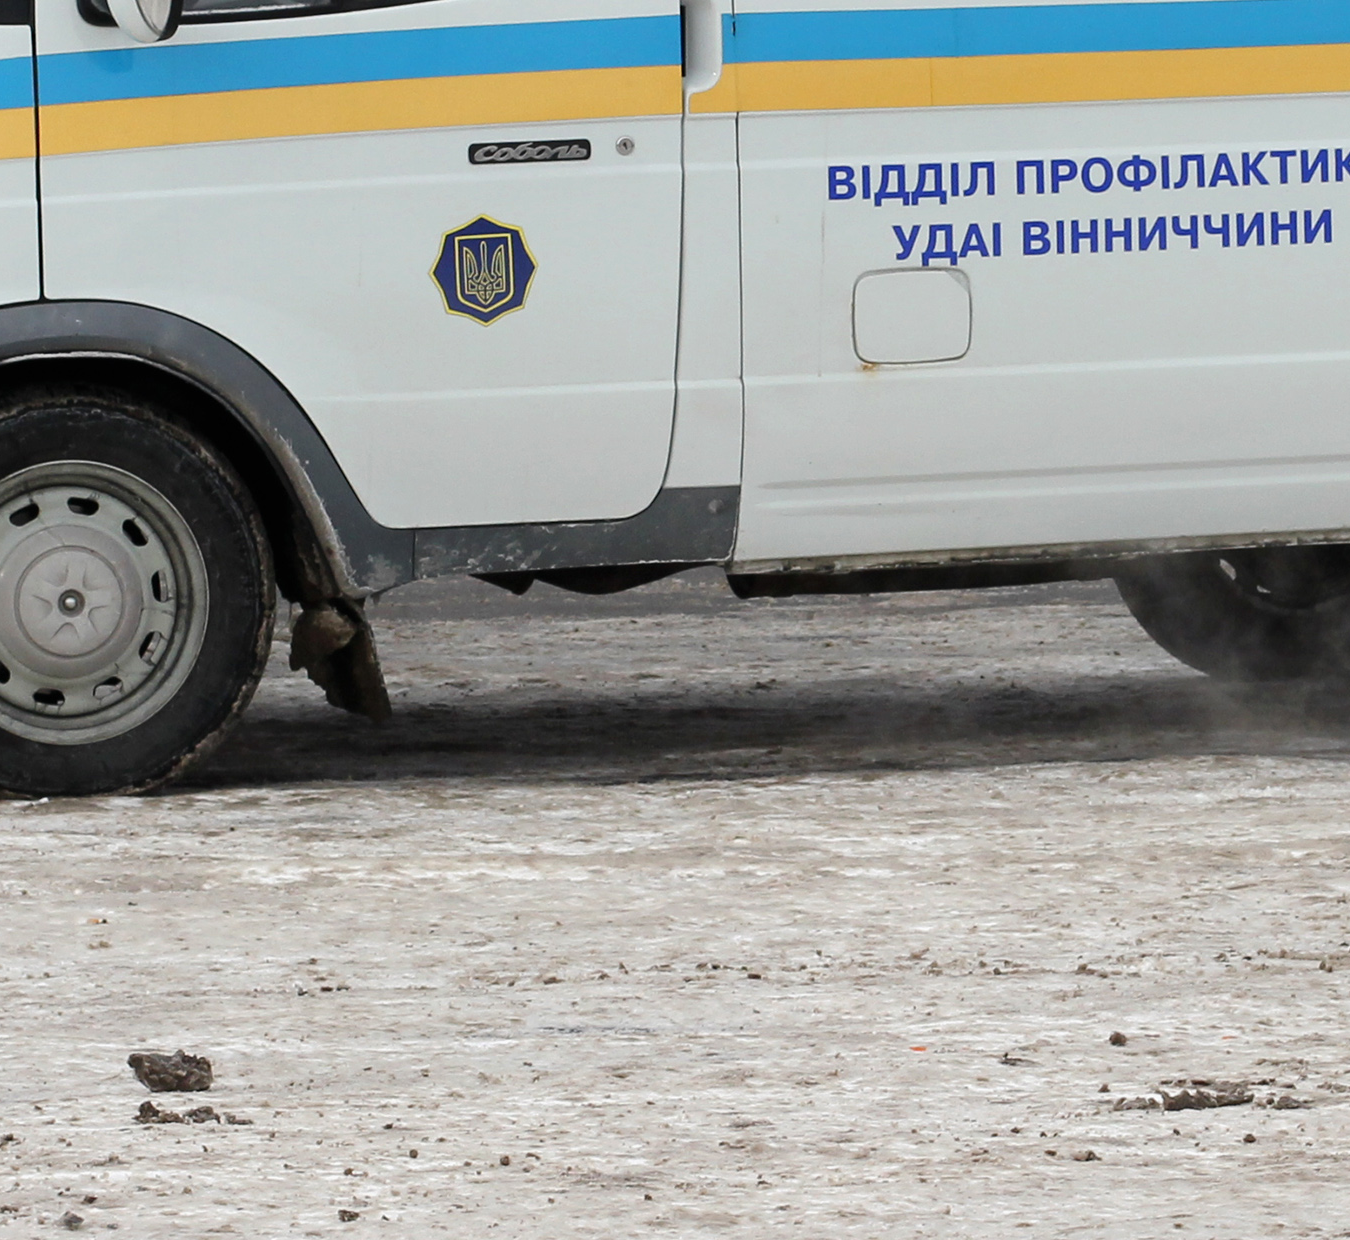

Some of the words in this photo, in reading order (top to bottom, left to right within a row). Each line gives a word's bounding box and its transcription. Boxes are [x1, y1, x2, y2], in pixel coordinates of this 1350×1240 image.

[827, 162, 995, 206] ВІДДІЛ
[892, 223, 1002, 265] УДАІ
[1022, 209, 1333, 256] ВІННИЧЧИНИ
